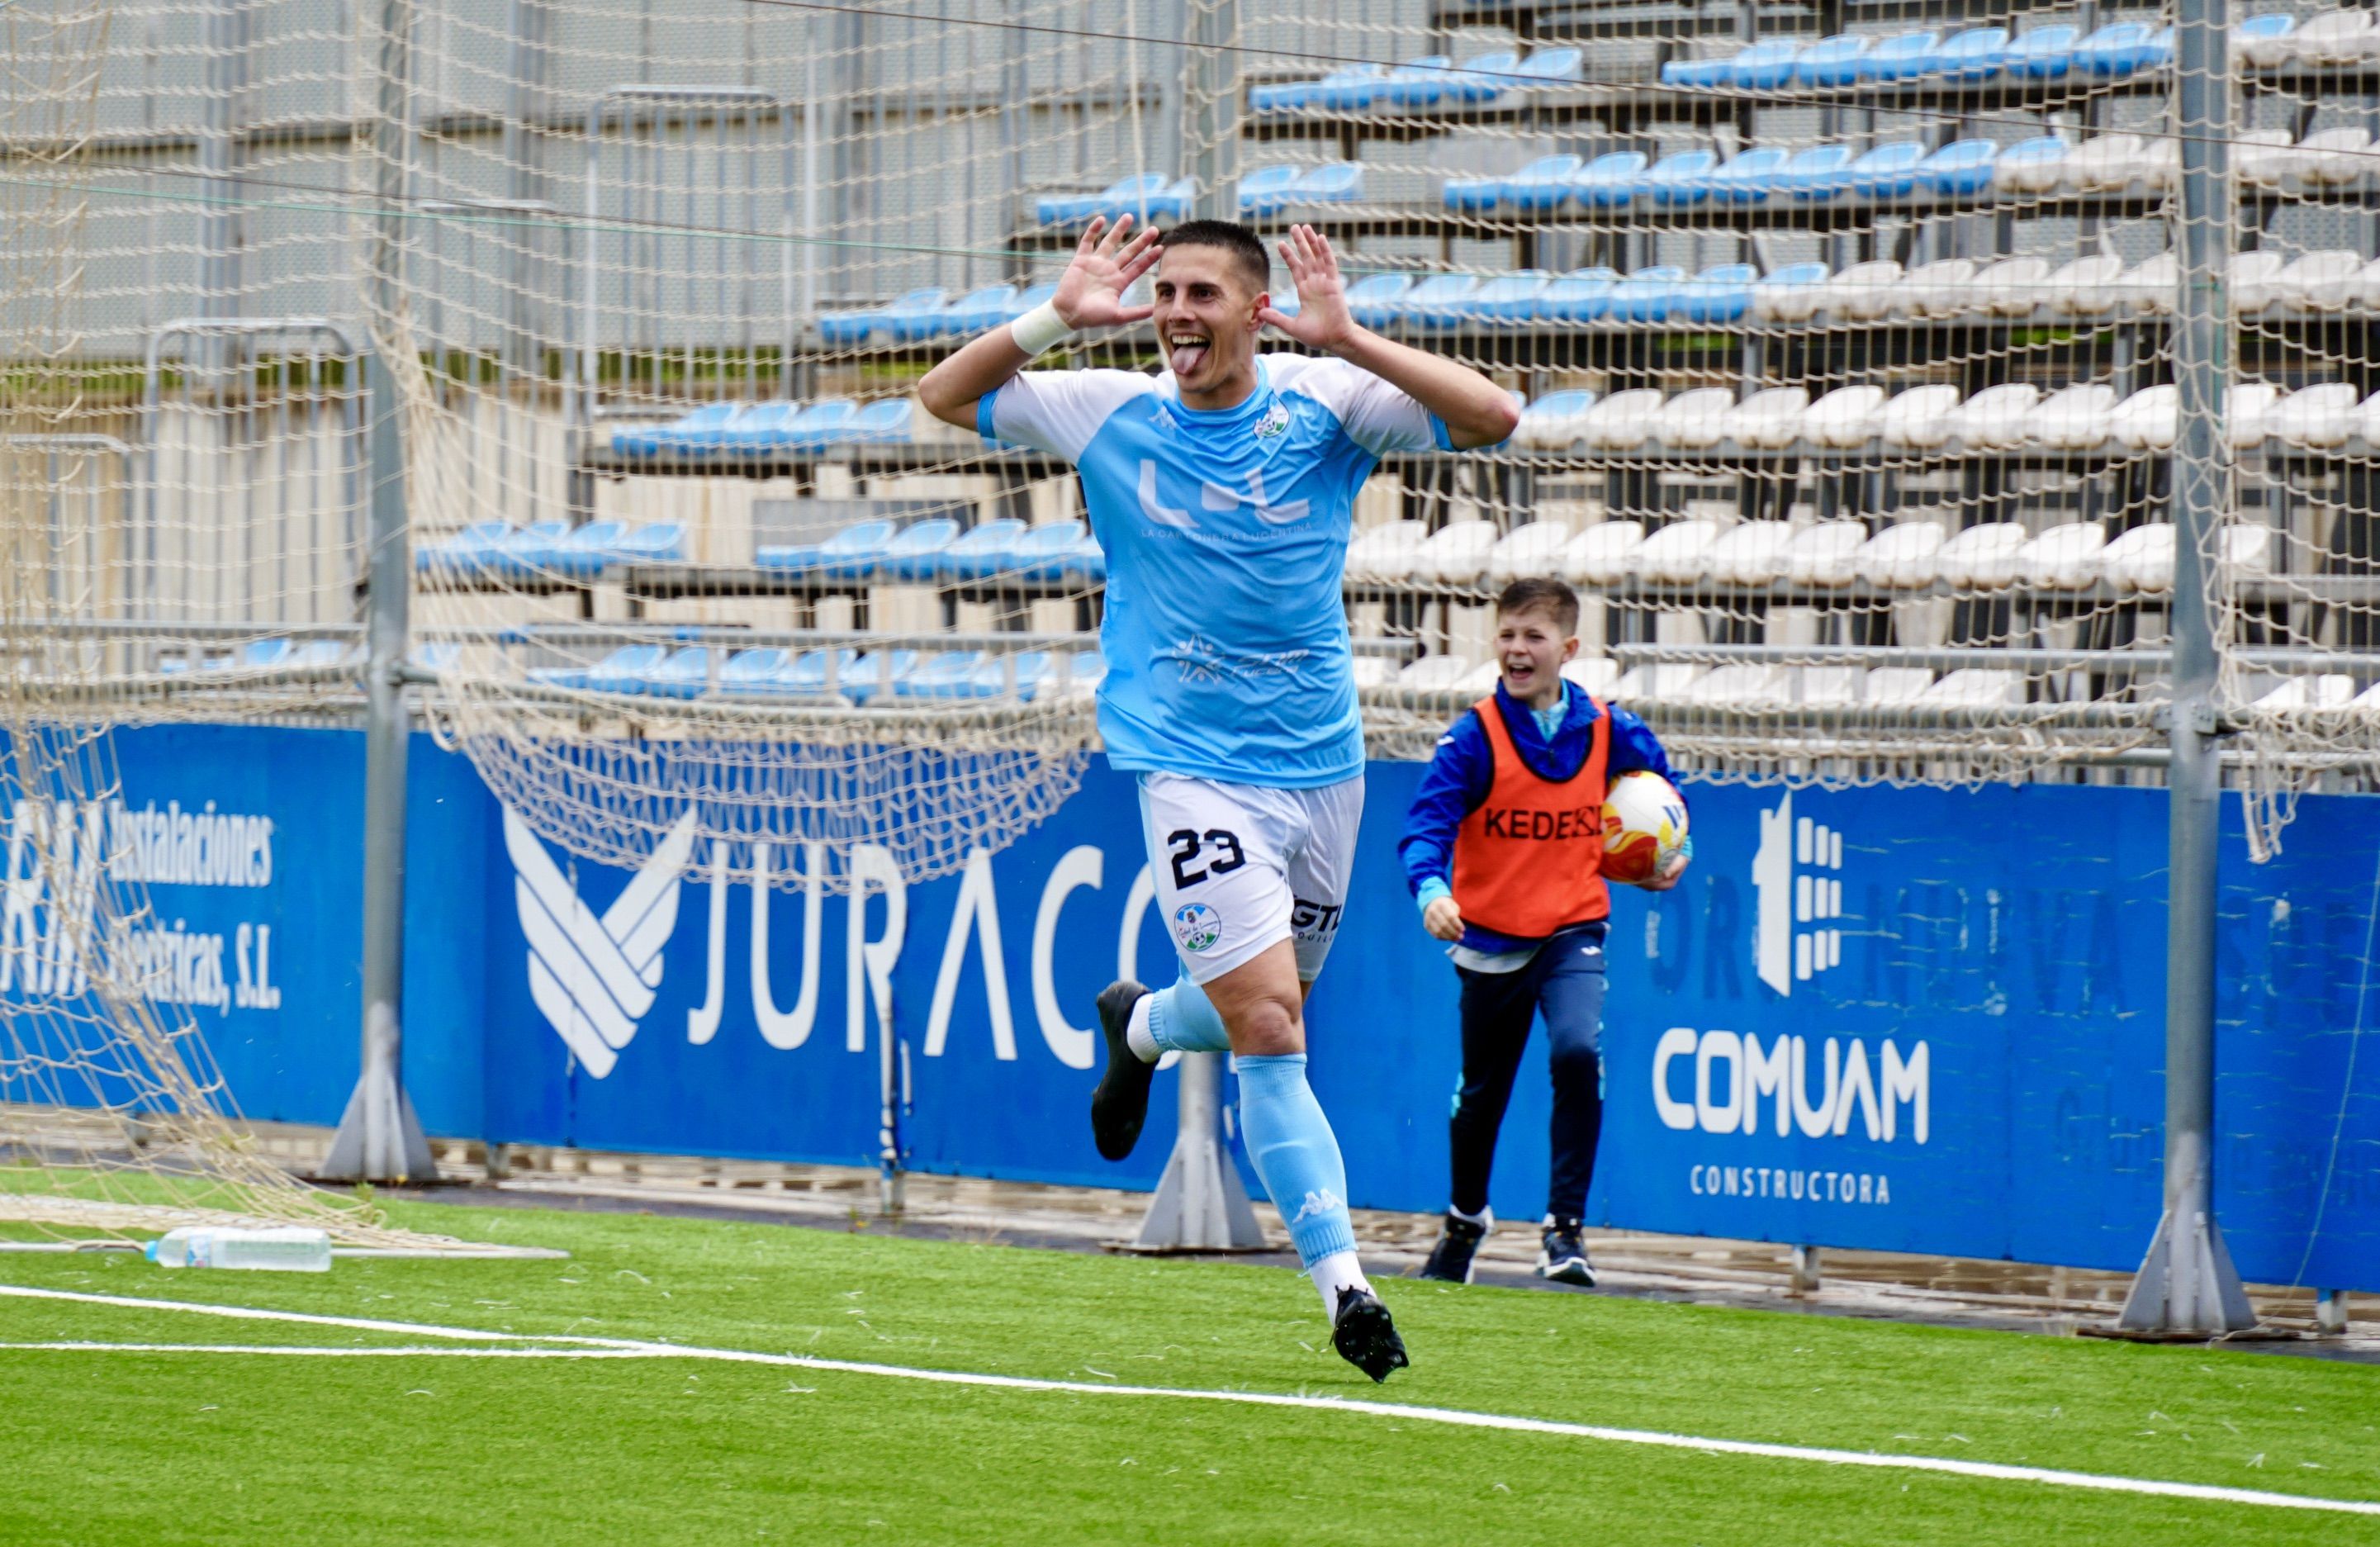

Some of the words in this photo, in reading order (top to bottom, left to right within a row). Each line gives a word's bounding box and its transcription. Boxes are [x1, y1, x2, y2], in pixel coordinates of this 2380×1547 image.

[1141, 529, 1154, 538] LA
[110, 797, 273, 888] Instalaciones
[1484, 804, 1602, 841] KEDEK
[1167, 828, 1246, 890] 23
[1652, 1027, 1930, 1145] COMUAM
[1690, 1164, 1890, 1205] CONSTRUCTORA
